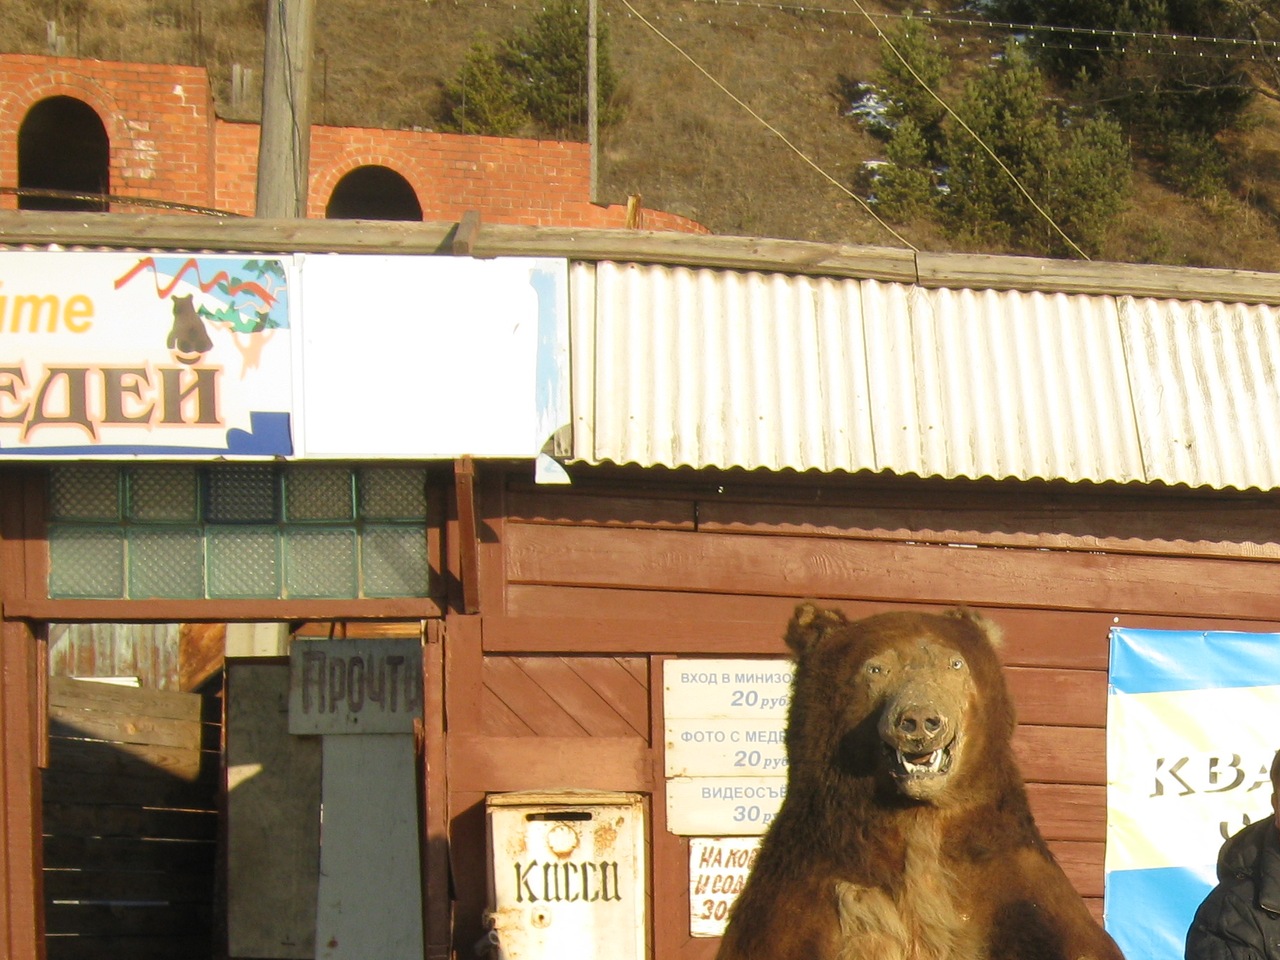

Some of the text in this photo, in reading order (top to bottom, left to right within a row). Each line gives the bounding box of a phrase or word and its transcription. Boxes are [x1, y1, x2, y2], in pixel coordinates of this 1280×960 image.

[681, 673, 717, 685] ВХОД
[722, 673, 730, 683] В
[731, 690, 758, 706] 20
[681, 731, 725, 742] ФОТО
[730, 731, 740, 742] С
[734, 751, 761, 766] 20
[733, 806, 760, 821] 30
[699, 846, 721, 868] НА
